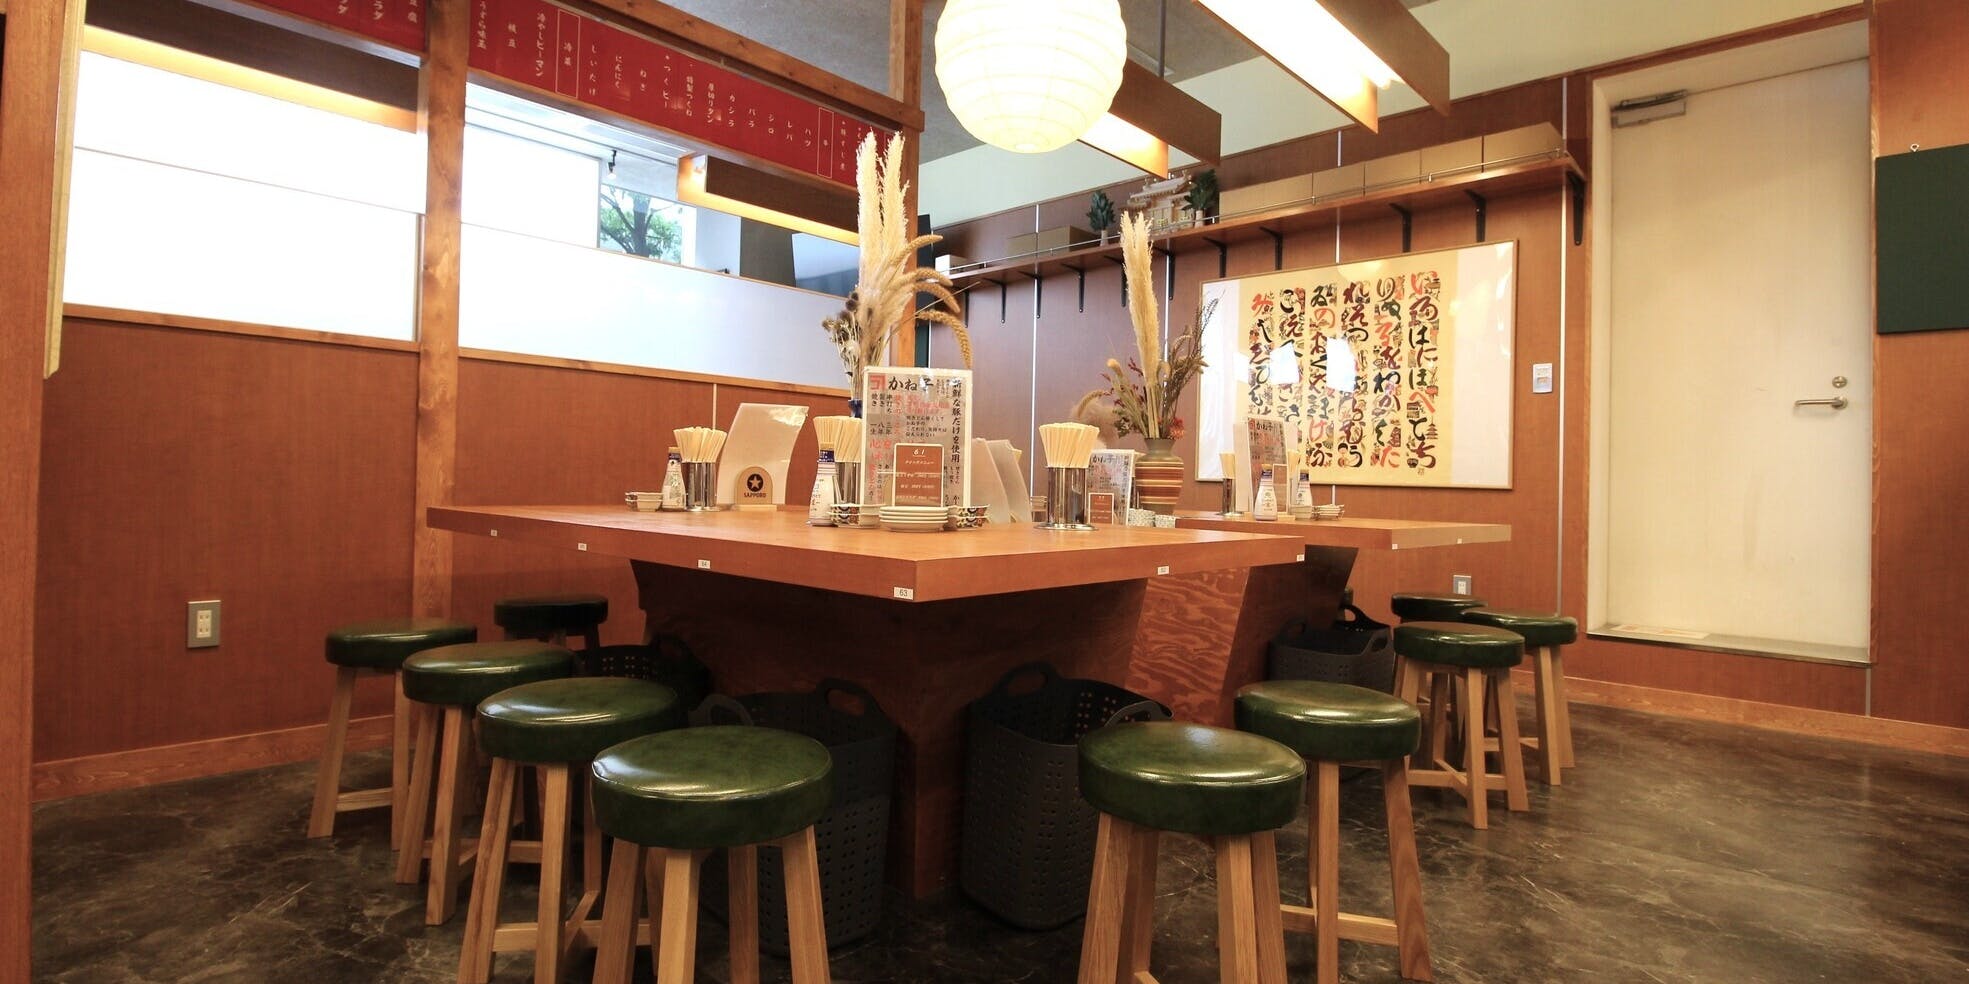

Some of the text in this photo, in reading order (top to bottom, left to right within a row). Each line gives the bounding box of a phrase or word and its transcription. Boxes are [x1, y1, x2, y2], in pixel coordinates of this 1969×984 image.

[589, 45, 598, 96] しいたけ
[899, 588, 908, 597] 63
